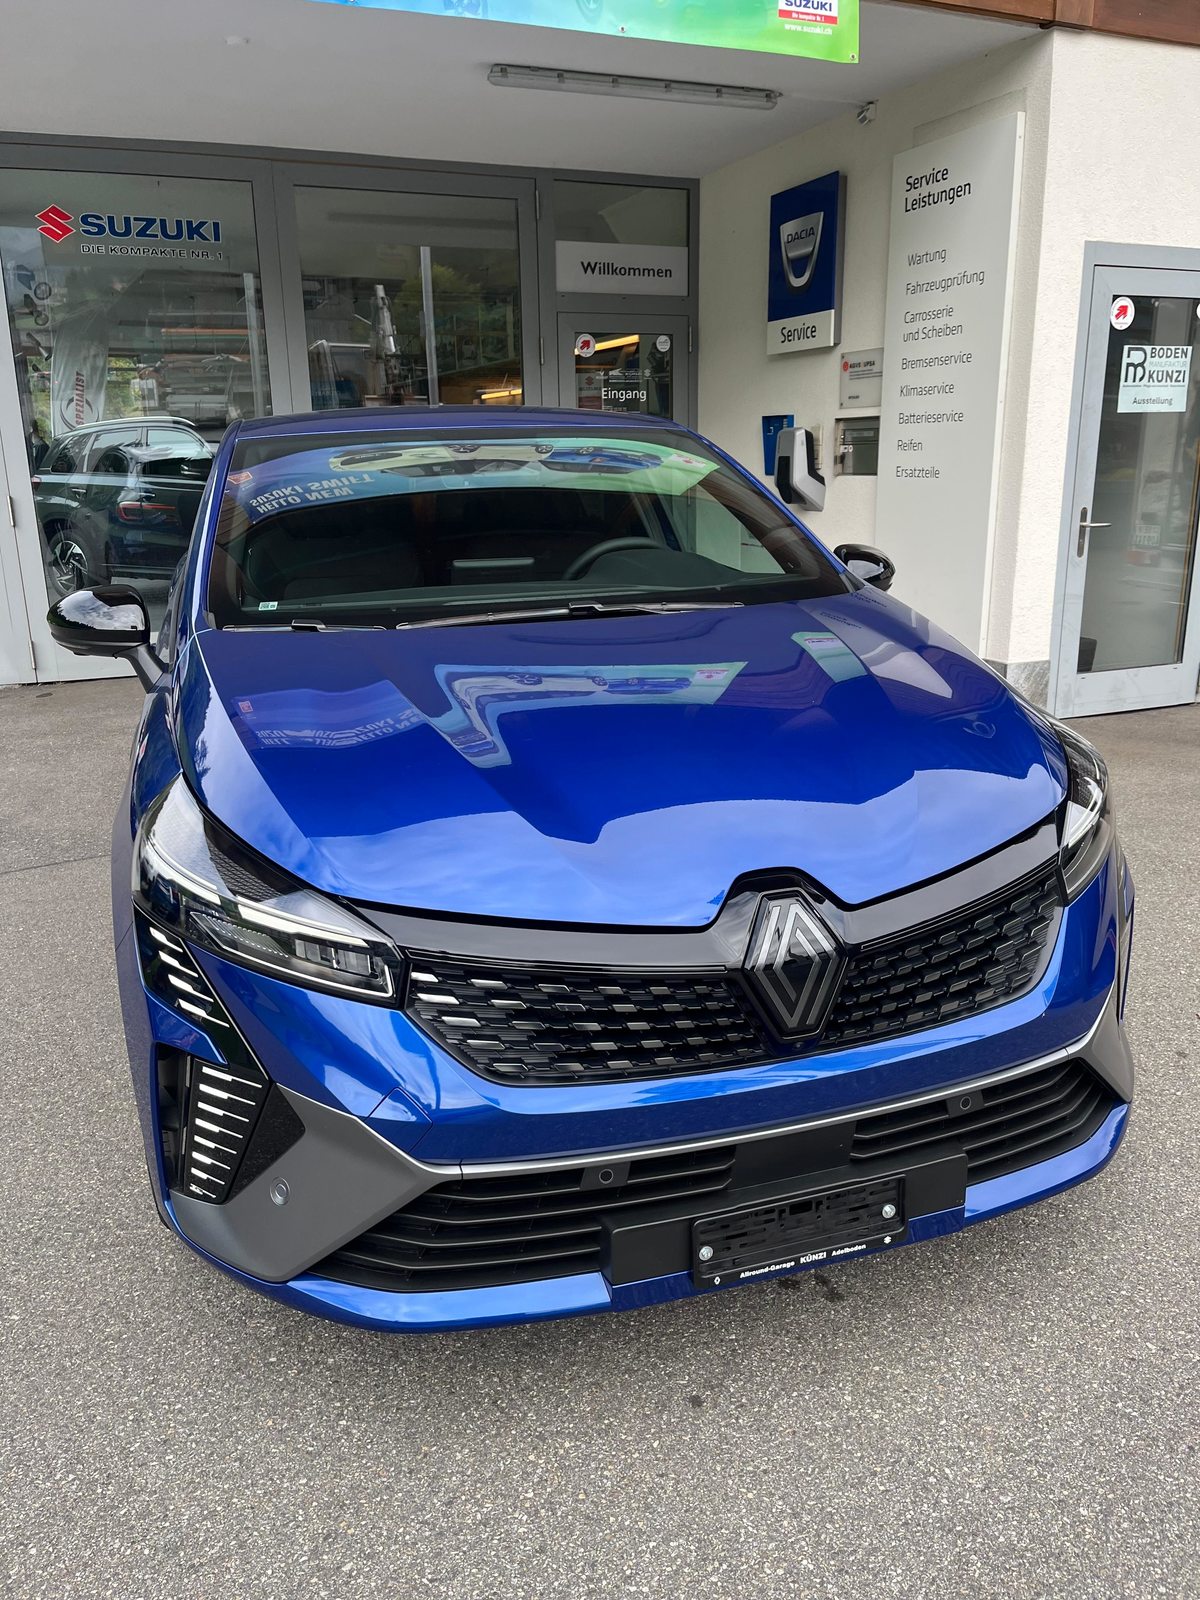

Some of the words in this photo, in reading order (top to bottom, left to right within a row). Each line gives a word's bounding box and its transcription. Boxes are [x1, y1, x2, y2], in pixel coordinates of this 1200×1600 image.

[784, 0, 832, 12] SUZUKI
[905, 168, 949, 192] Service
[904, 182, 972, 213] Leistungen
[79, 213, 222, 243] SUZUKI
[786, 227, 815, 244] DACIA
[81, 244, 105, 254] DIE
[109, 245, 187, 258] KOMPAKTE
[191, 250, 215, 260] NR.
[217, 252, 223, 261] 1
[907, 249, 947, 266] Wartung
[580, 261, 672, 278] Willkommen
[906, 270, 985, 295] Fahrzeugprüfung
[904, 304, 954, 324] Carrosserie
[781, 323, 817, 344] Service
[903, 328, 919, 342] und
[921, 323, 963, 340] Scheiben
[901, 351, 973, 370] Bremsenservice
[1150, 347, 1189, 359] BODEN
[602, 388, 647, 401] Eingang
[899, 382, 955, 397] Klimaservice
[1132, 396, 1173, 405] Ausstellung
[898, 410, 964, 424] Batterieservice
[897, 439, 923, 451] Reifen
[895, 466, 940, 478] Ersatzteile
[740, 1261, 795, 1278] Allround-Garage
[831, 1244, 866, 1257] Adelboden
